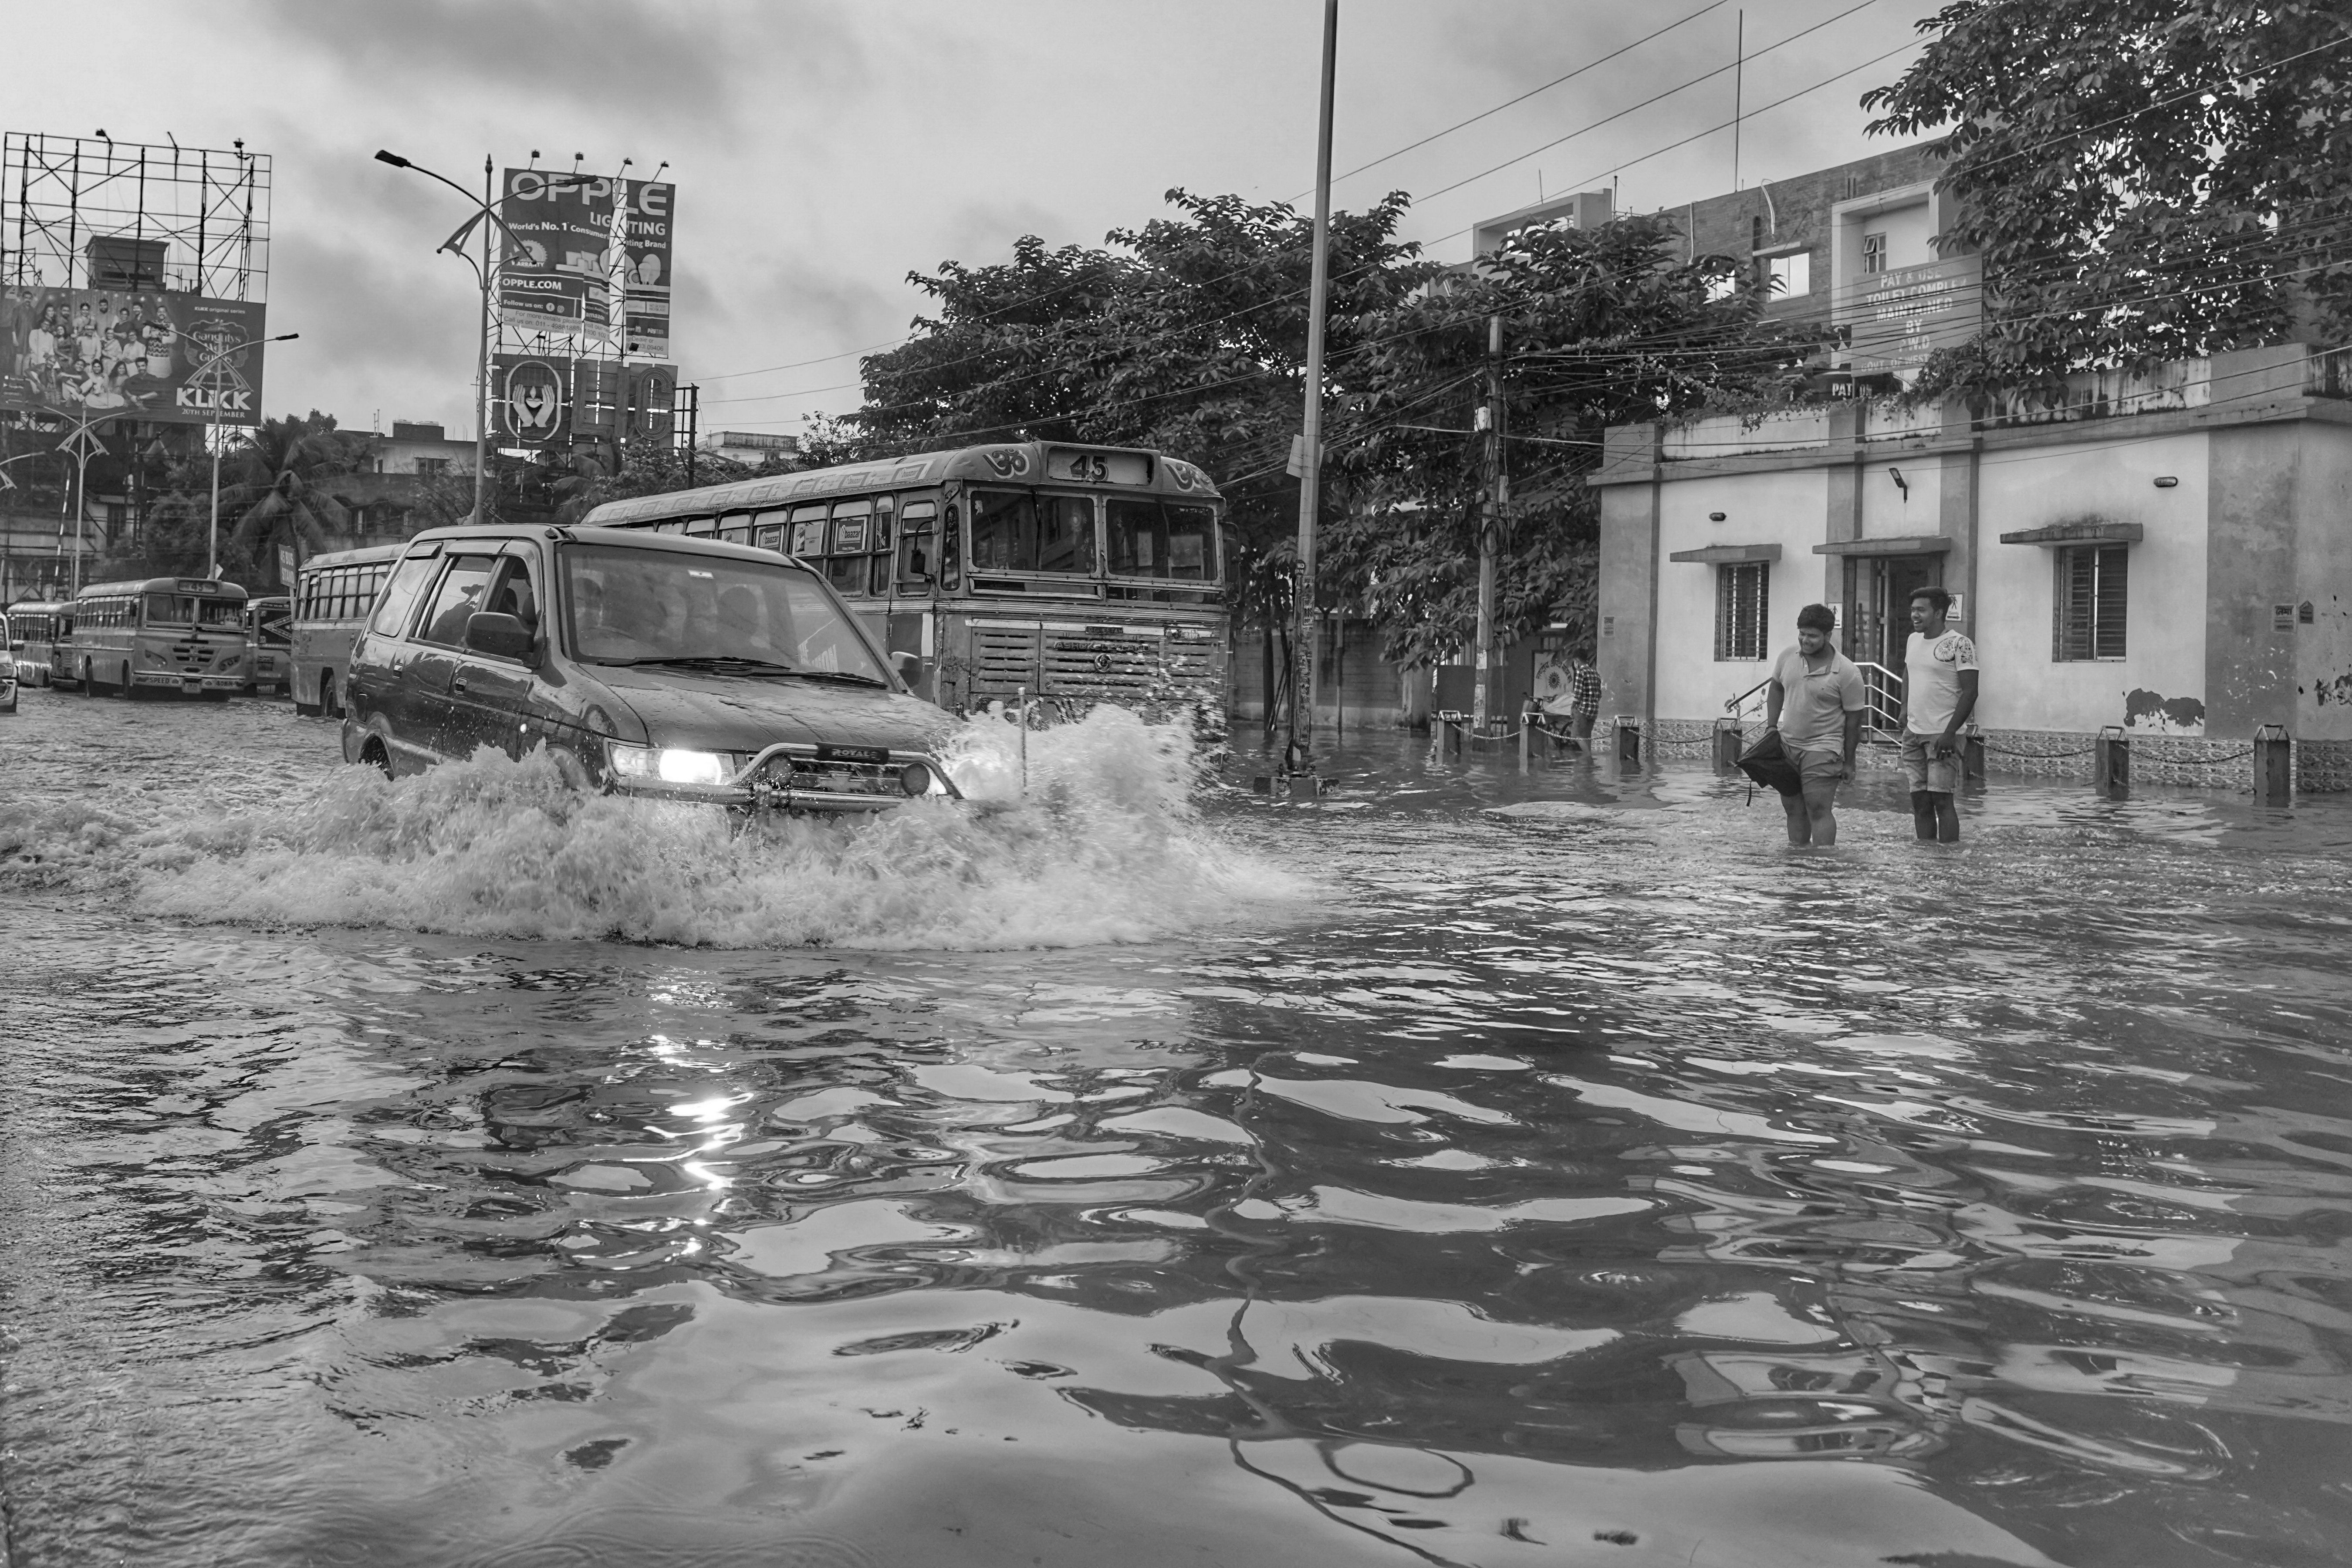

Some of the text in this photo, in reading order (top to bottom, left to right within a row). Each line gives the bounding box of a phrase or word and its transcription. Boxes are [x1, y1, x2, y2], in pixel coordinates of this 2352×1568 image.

[590, 212, 666, 236] LIGTING
[541, 222, 559, 230] No.
[645, 240, 666, 249] Brand
[502, 278, 562, 291] OPPLE.COM
[1881, 272, 1902, 288] PAY
[1918, 268, 1942, 281] USE
[1906, 319, 1923, 334] BY
[193, 331, 241, 345] Ganglys
[176, 387, 251, 411] KLIKK
[202, 409, 246, 419] SEPEMBER
[1070, 455, 1110, 480] 45
